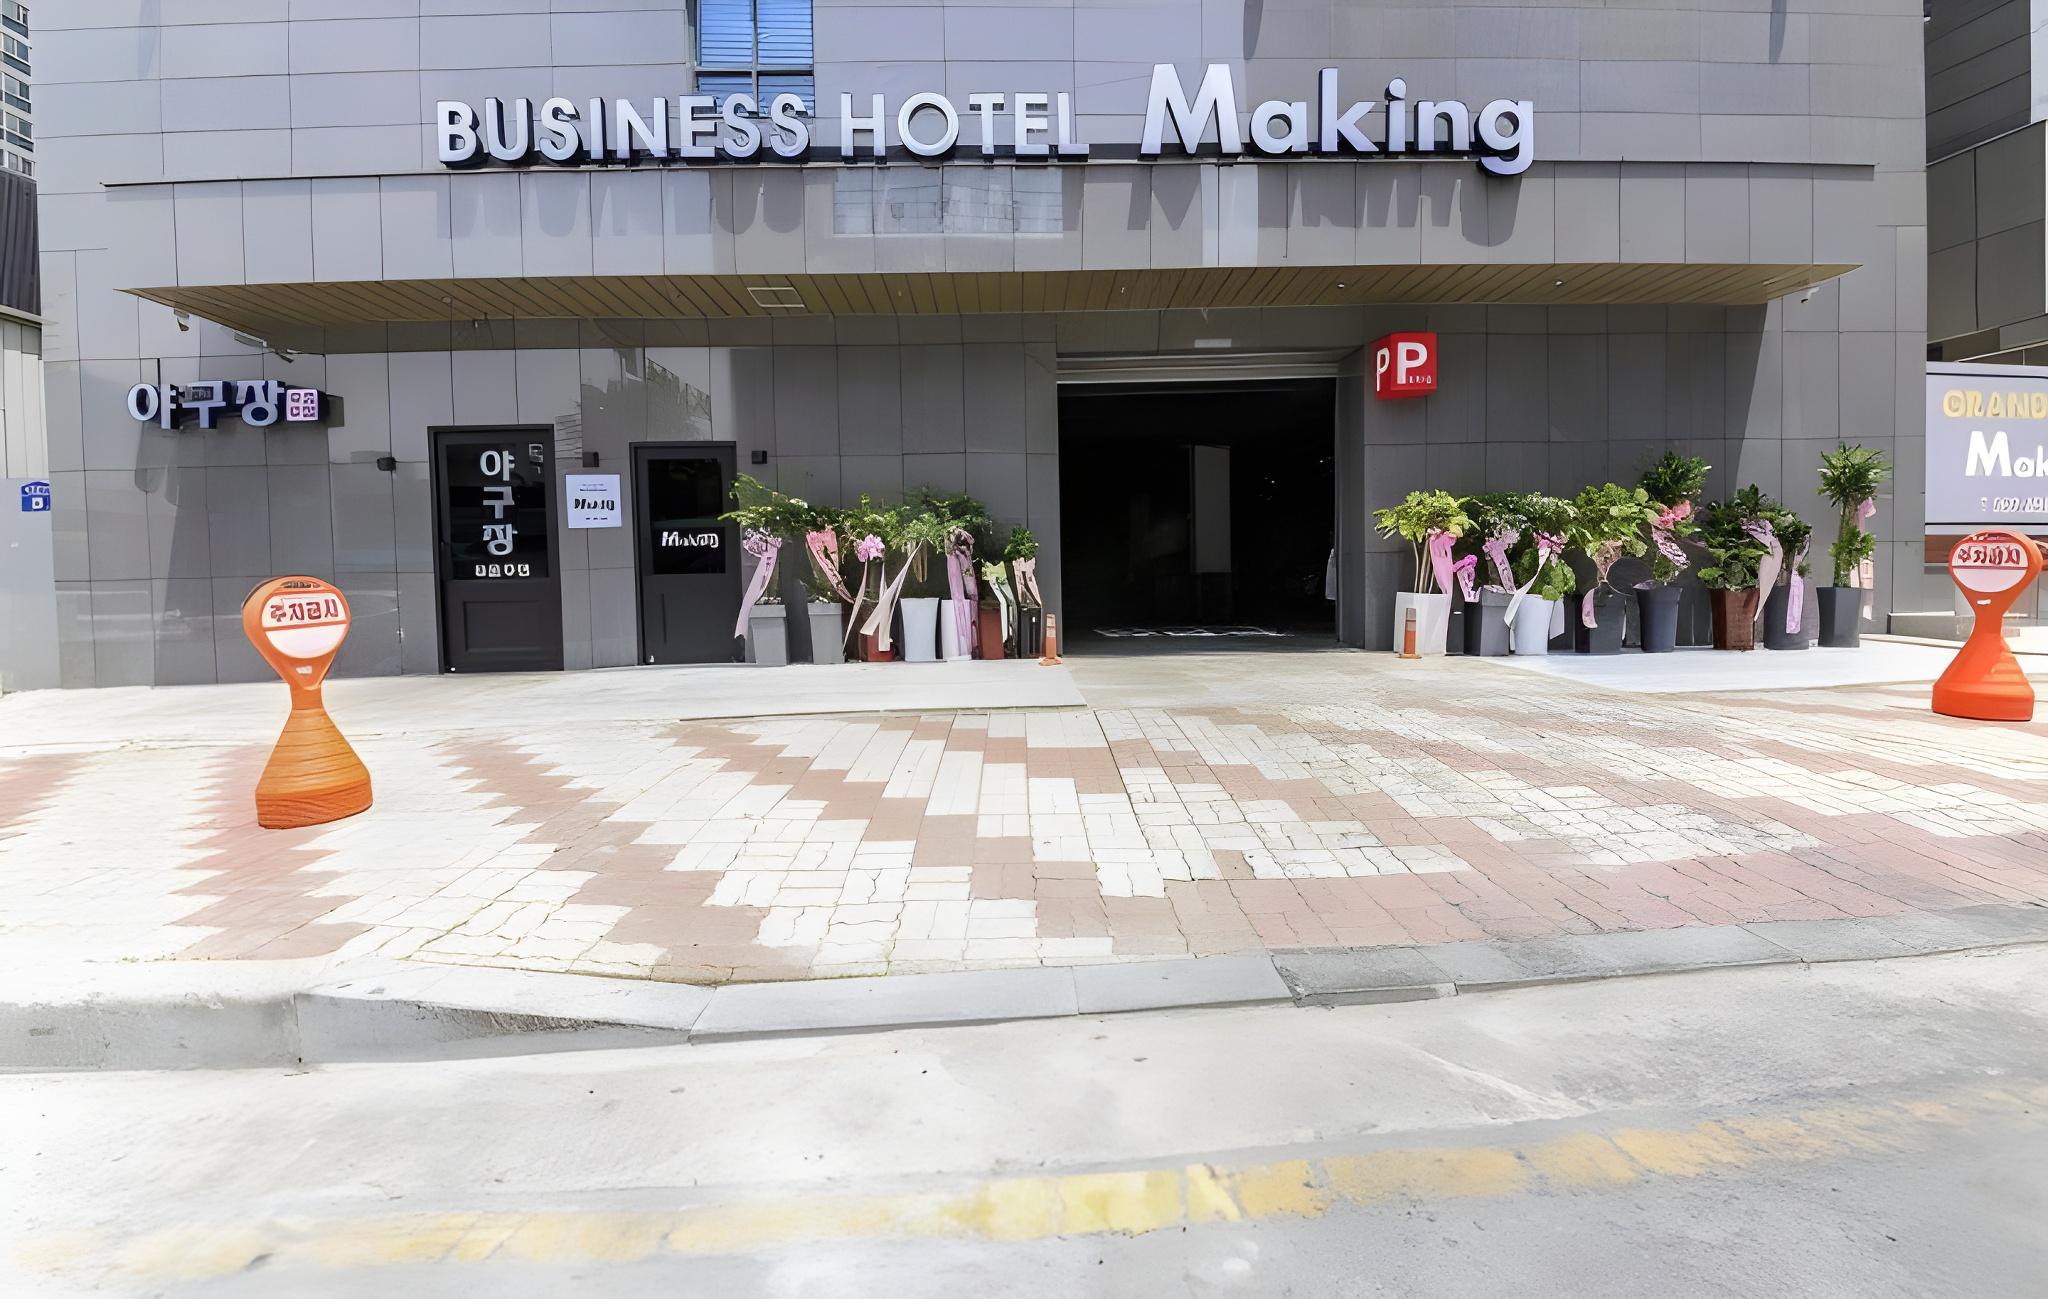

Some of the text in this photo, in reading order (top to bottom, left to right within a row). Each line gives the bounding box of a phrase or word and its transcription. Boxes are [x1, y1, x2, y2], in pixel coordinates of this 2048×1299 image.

[436, 63, 1535, 176] BUSINESS HOTEL Making
[1376, 347, 1390, 392] P
[1396, 341, 1428, 385] P
[127, 380, 285, 430] 야구장
[1942, 389, 2048, 420] GRAND
